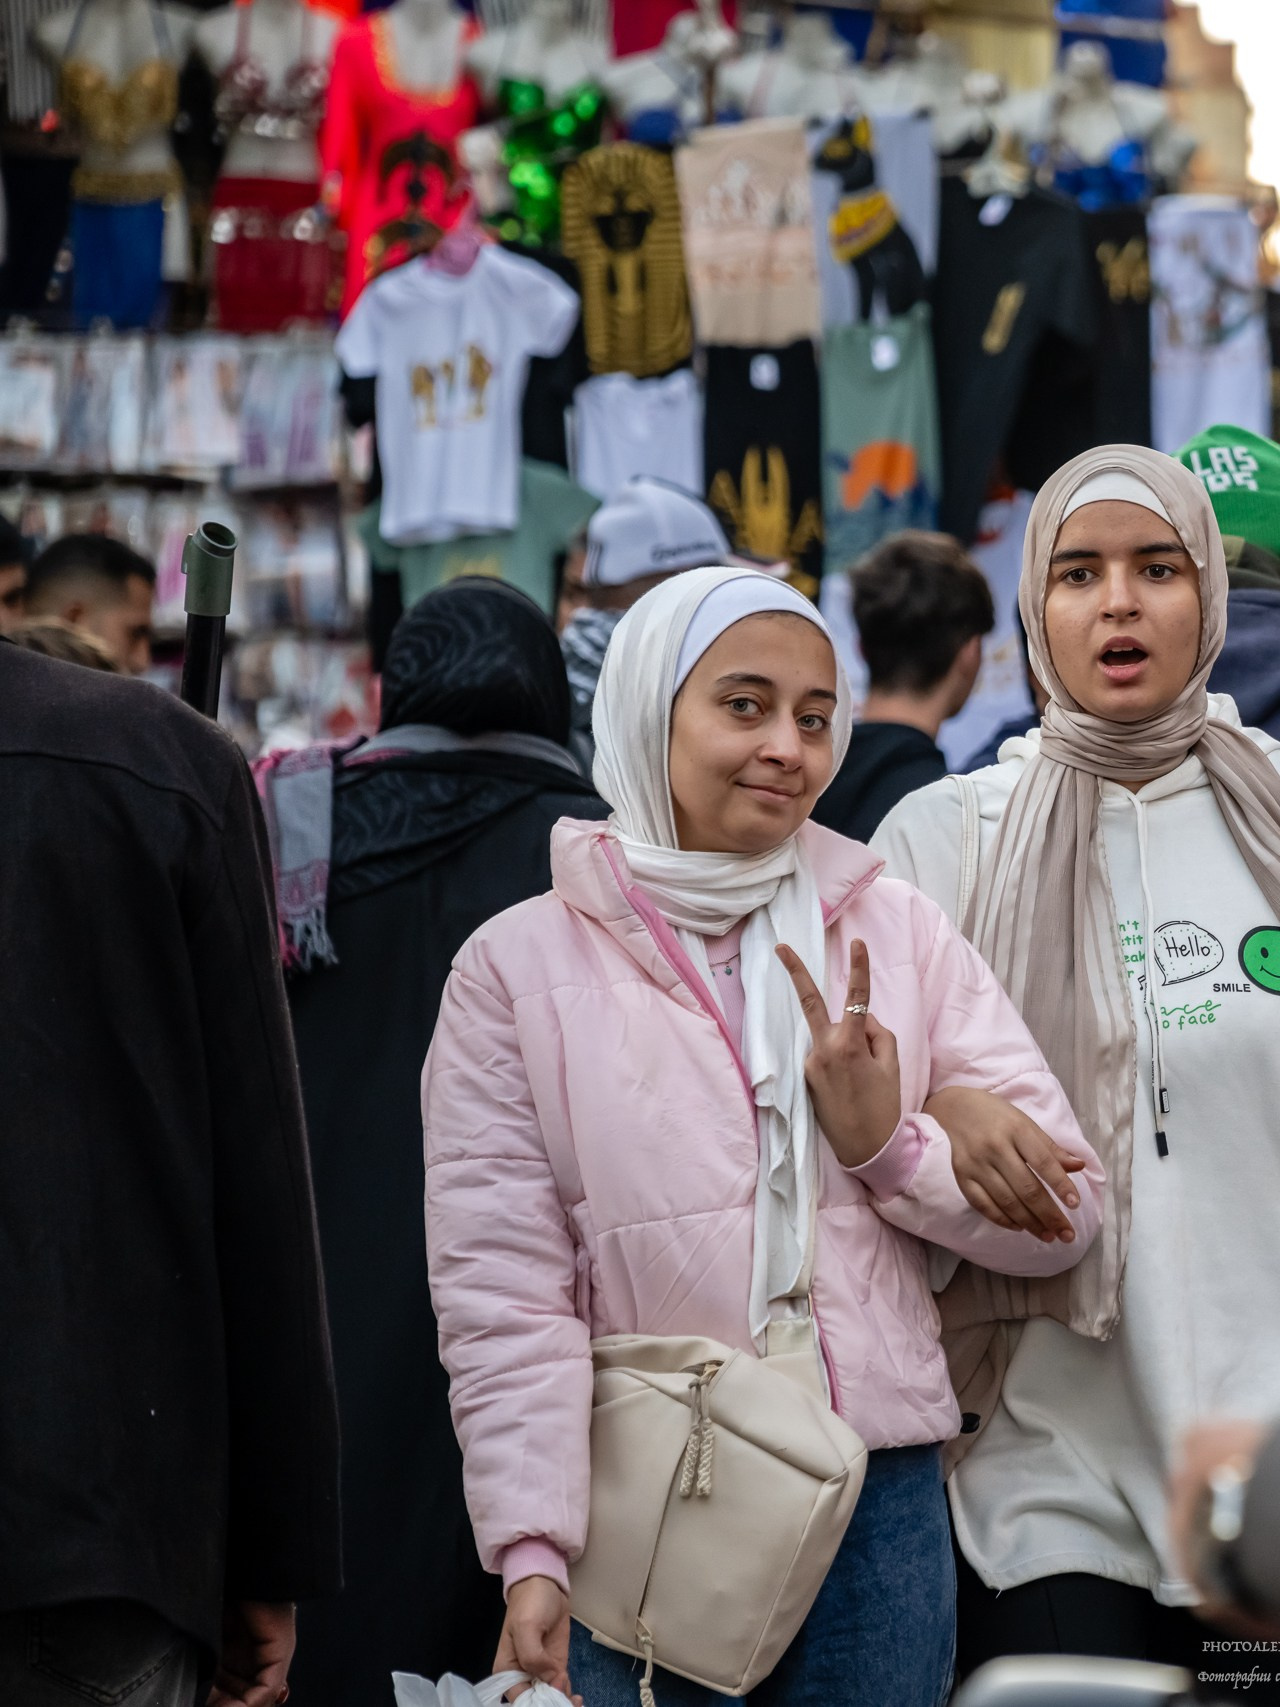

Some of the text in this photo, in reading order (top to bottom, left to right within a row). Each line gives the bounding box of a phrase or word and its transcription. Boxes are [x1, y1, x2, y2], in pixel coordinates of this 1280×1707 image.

[1163, 934, 1211, 958] Hello
[1212, 983, 1251, 993] SMILE
[1160, 999, 1222, 1016] ace
[1178, 1012, 1217, 1030] face
